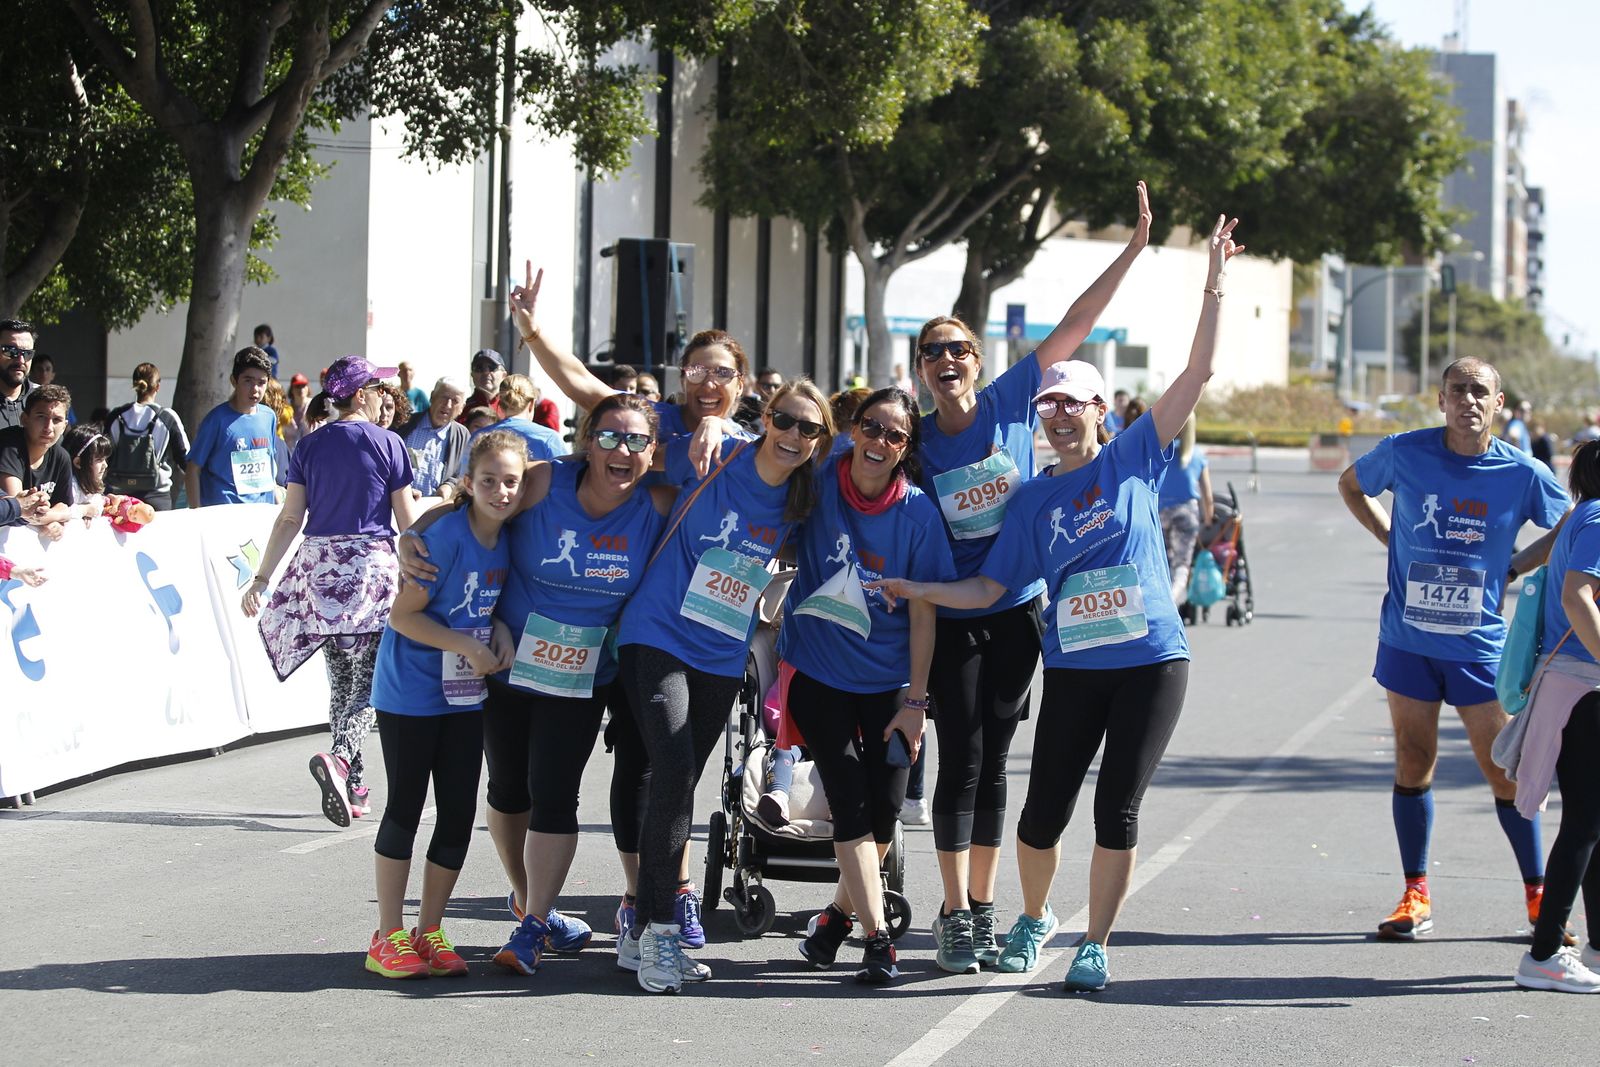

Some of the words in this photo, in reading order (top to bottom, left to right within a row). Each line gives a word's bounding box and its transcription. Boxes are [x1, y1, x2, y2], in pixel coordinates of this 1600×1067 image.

[239, 462, 266, 475] 2237
[954, 476, 1009, 511] 2096
[971, 503, 986, 512] MAR
[1451, 497, 1488, 516] VIII
[1448, 516, 1487, 527] CARRERA
[589, 534, 628, 551] VIII
[586, 552, 630, 562] CARRERA
[705, 571, 750, 603] 2095
[1420, 584, 1470, 604] 1474
[1069, 589, 1127, 616] 2030
[1082, 609, 1118, 619] MERCEDES
[532, 640, 588, 665] 2029
[534, 657, 555, 667] MARIA
